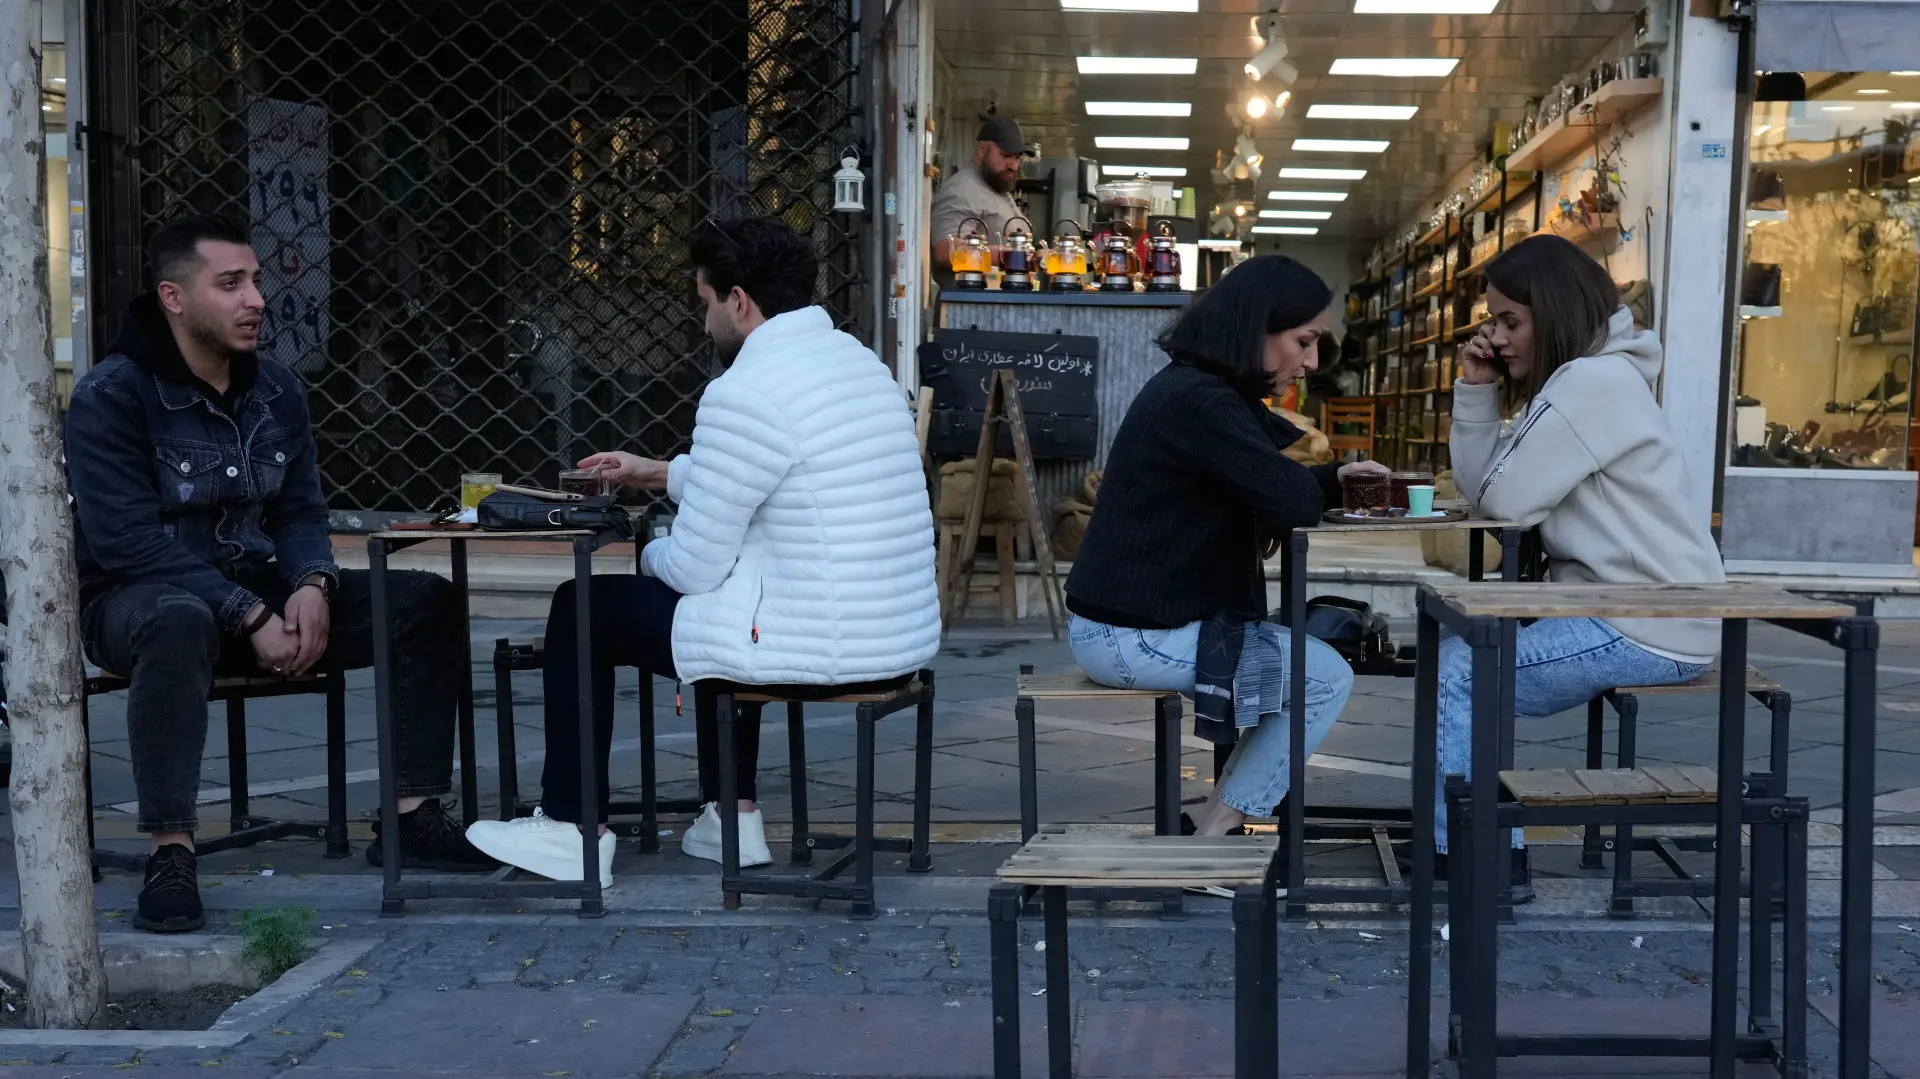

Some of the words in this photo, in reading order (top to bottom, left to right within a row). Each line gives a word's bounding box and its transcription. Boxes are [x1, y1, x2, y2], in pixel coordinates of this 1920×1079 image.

[942, 341, 974, 363] ایران
[977, 350, 1014, 366] عطاری
[1048, 353, 1080, 373] اولین
